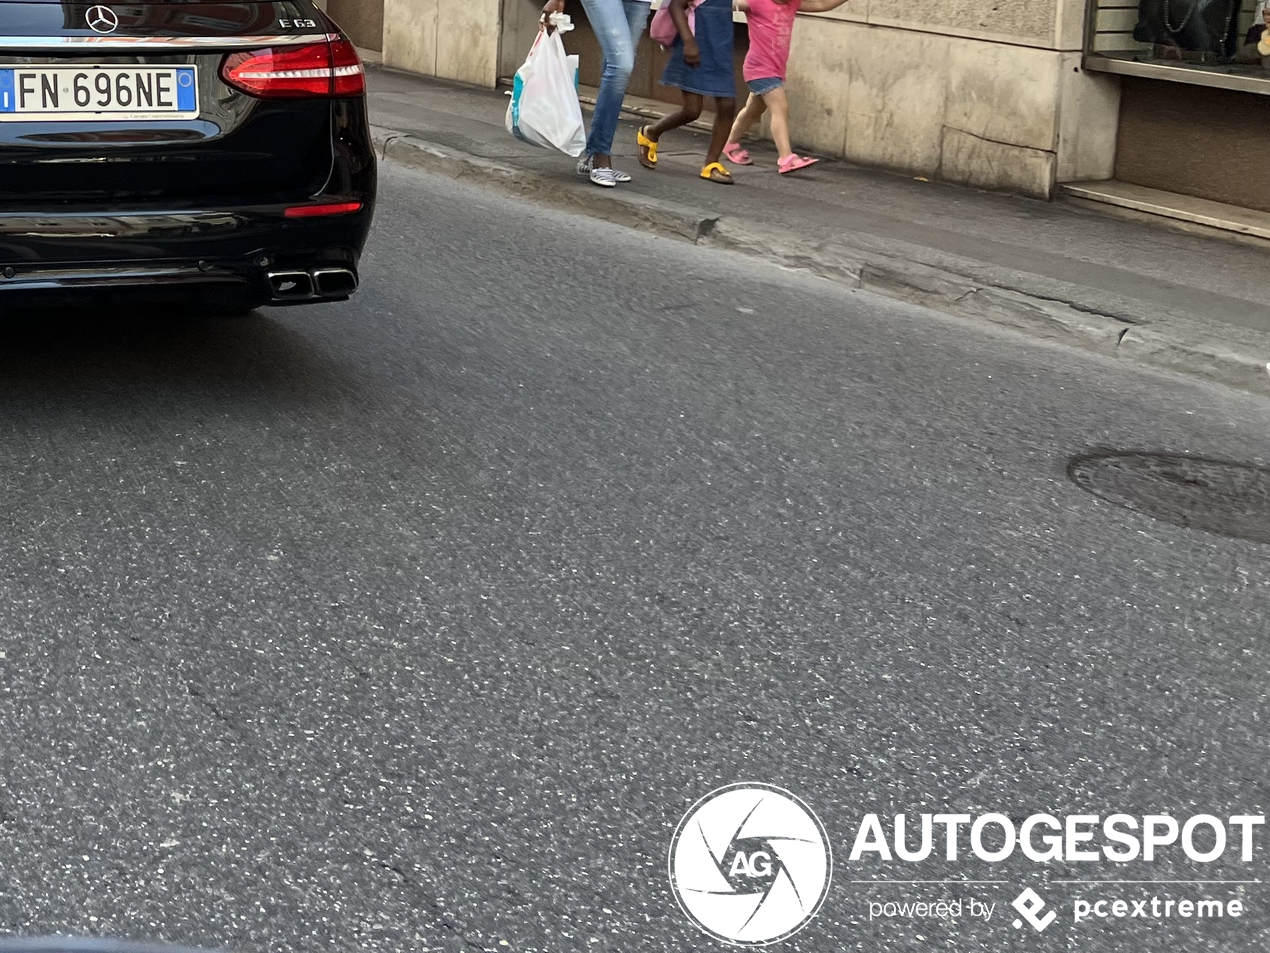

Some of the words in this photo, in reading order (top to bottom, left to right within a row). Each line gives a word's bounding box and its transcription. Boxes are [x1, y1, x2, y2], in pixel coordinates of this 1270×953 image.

[278, 18, 292, 28] E
[293, 18, 316, 28] 63
[19, 73, 59, 108] FN
[73, 72, 173, 108] 696NE
